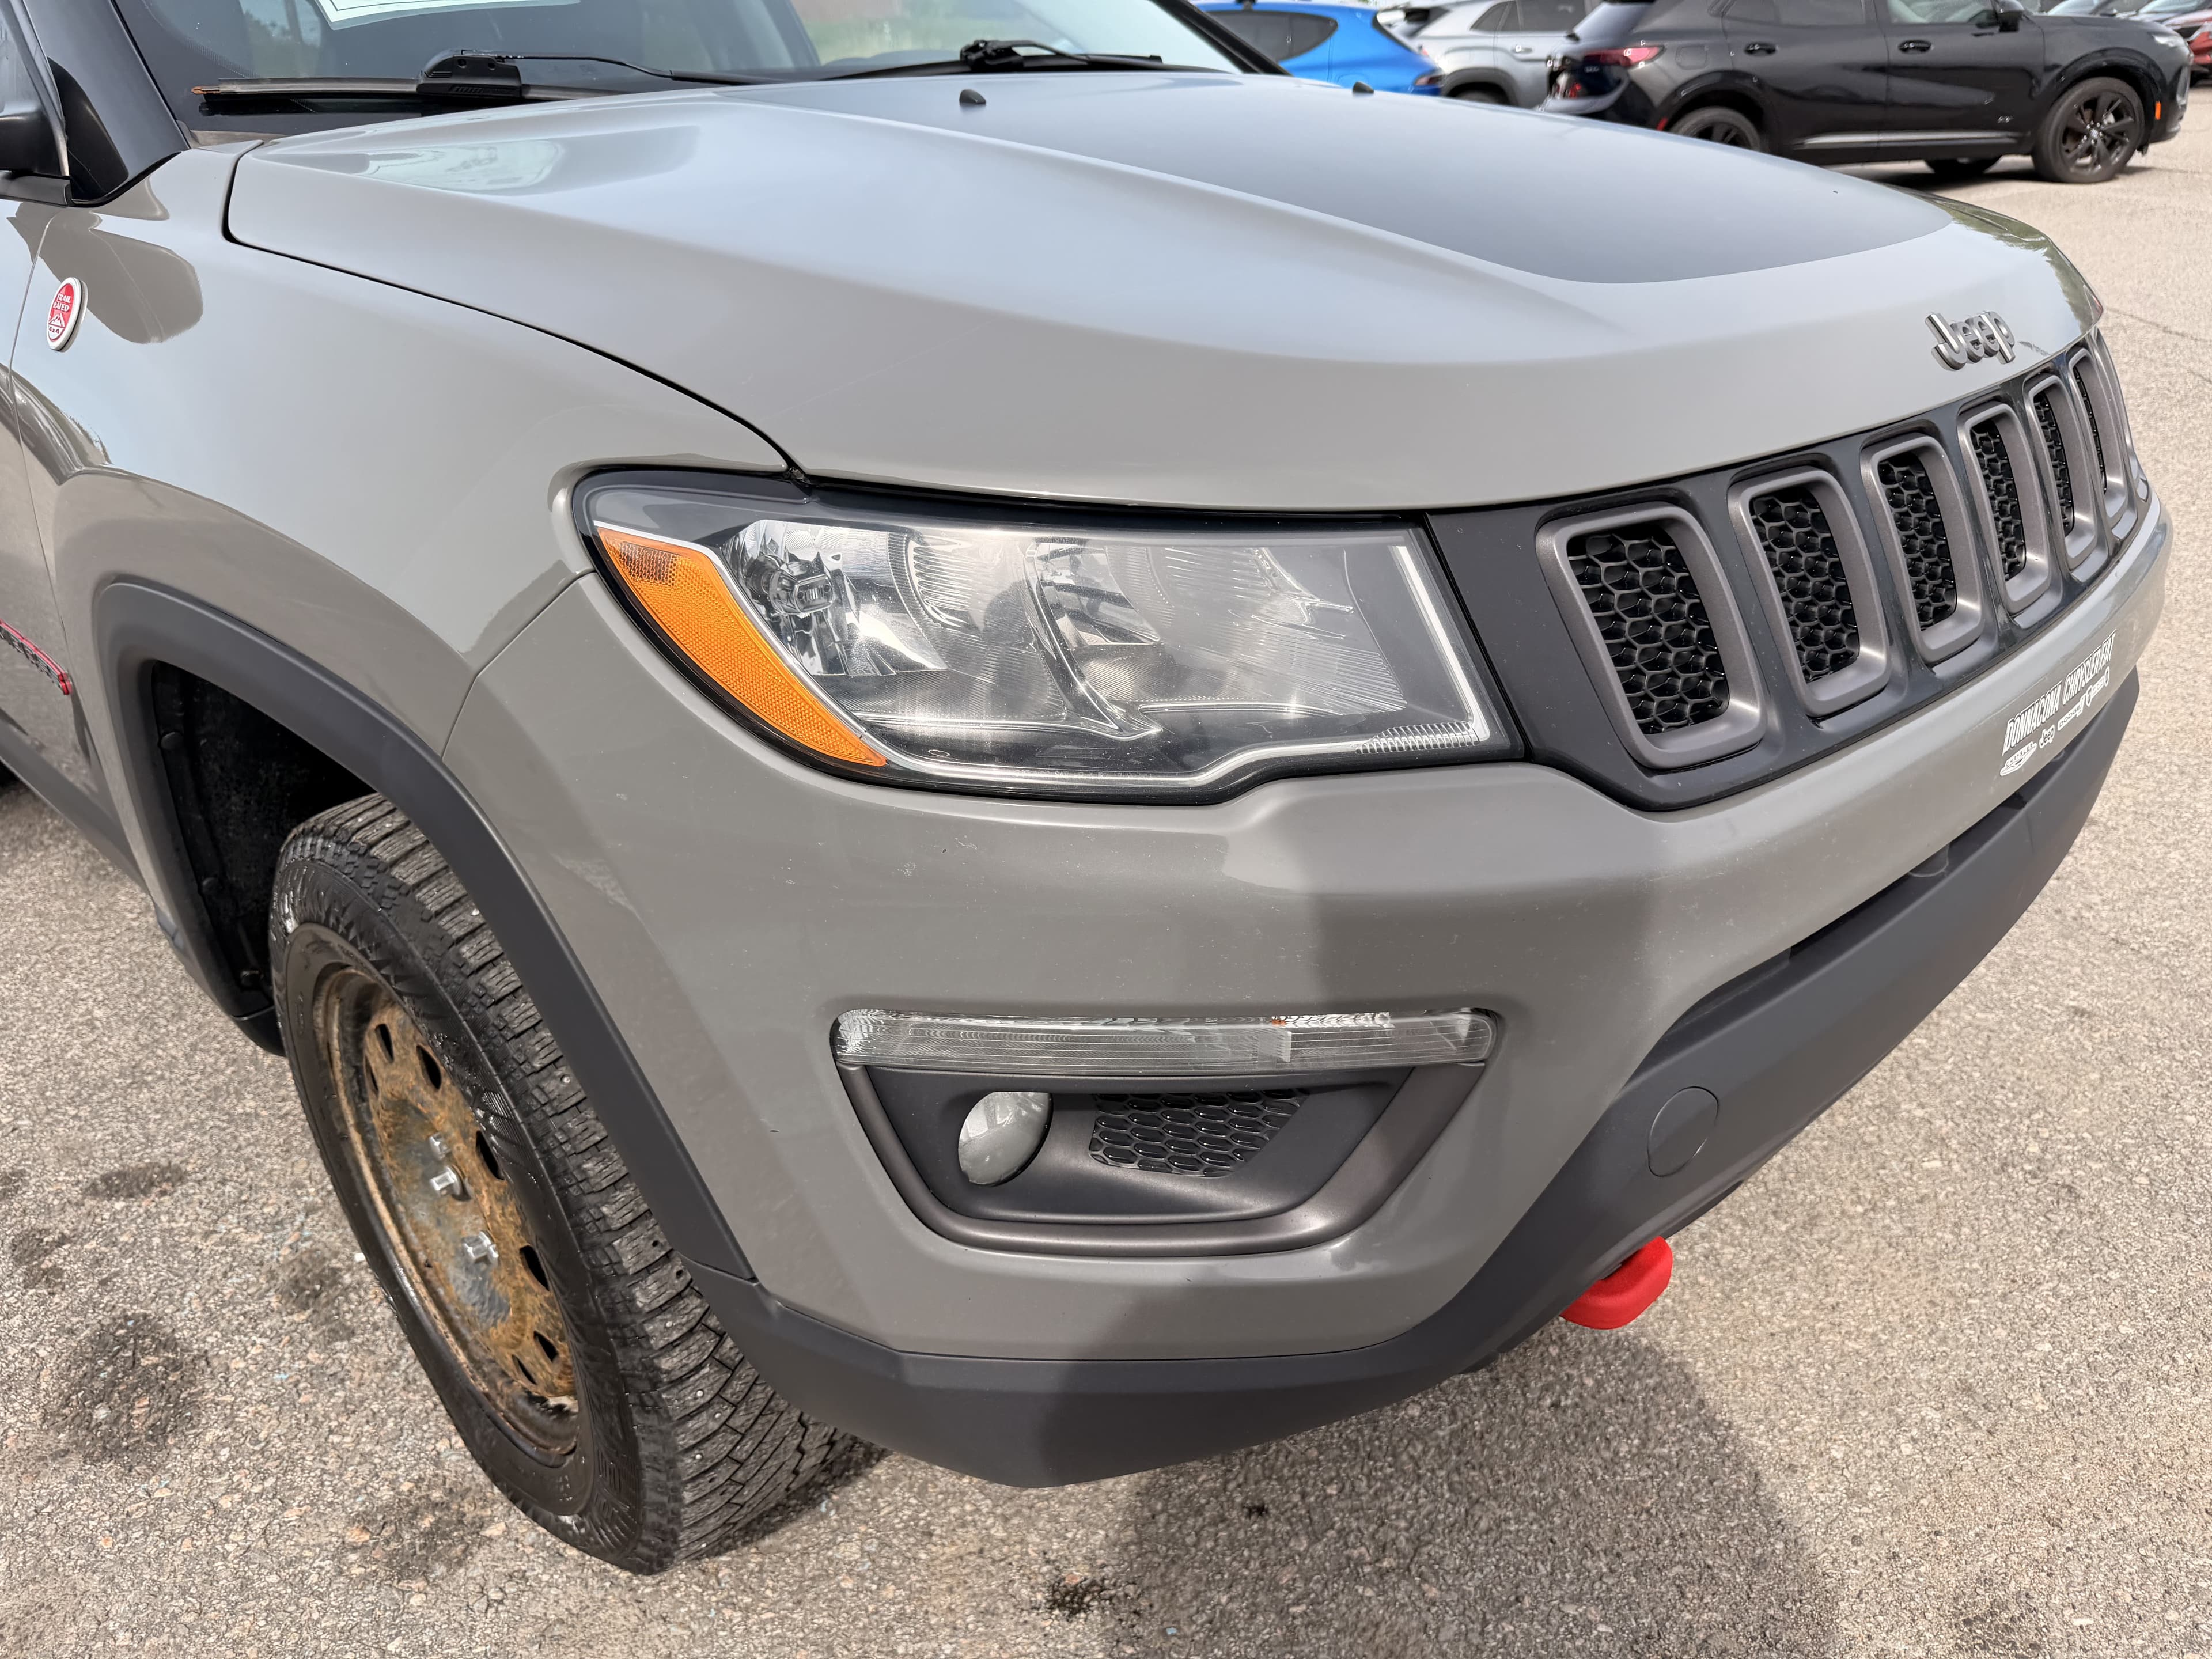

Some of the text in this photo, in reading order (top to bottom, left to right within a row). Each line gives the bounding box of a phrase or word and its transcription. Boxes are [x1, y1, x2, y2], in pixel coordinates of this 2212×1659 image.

[53, 301, 70, 312] RATED
[56, 293, 71, 304] TRAIL
[1925, 311, 2016, 370] Jeep
[2002, 628, 2116, 756] DONNACONA CHRYSLER FIAT
